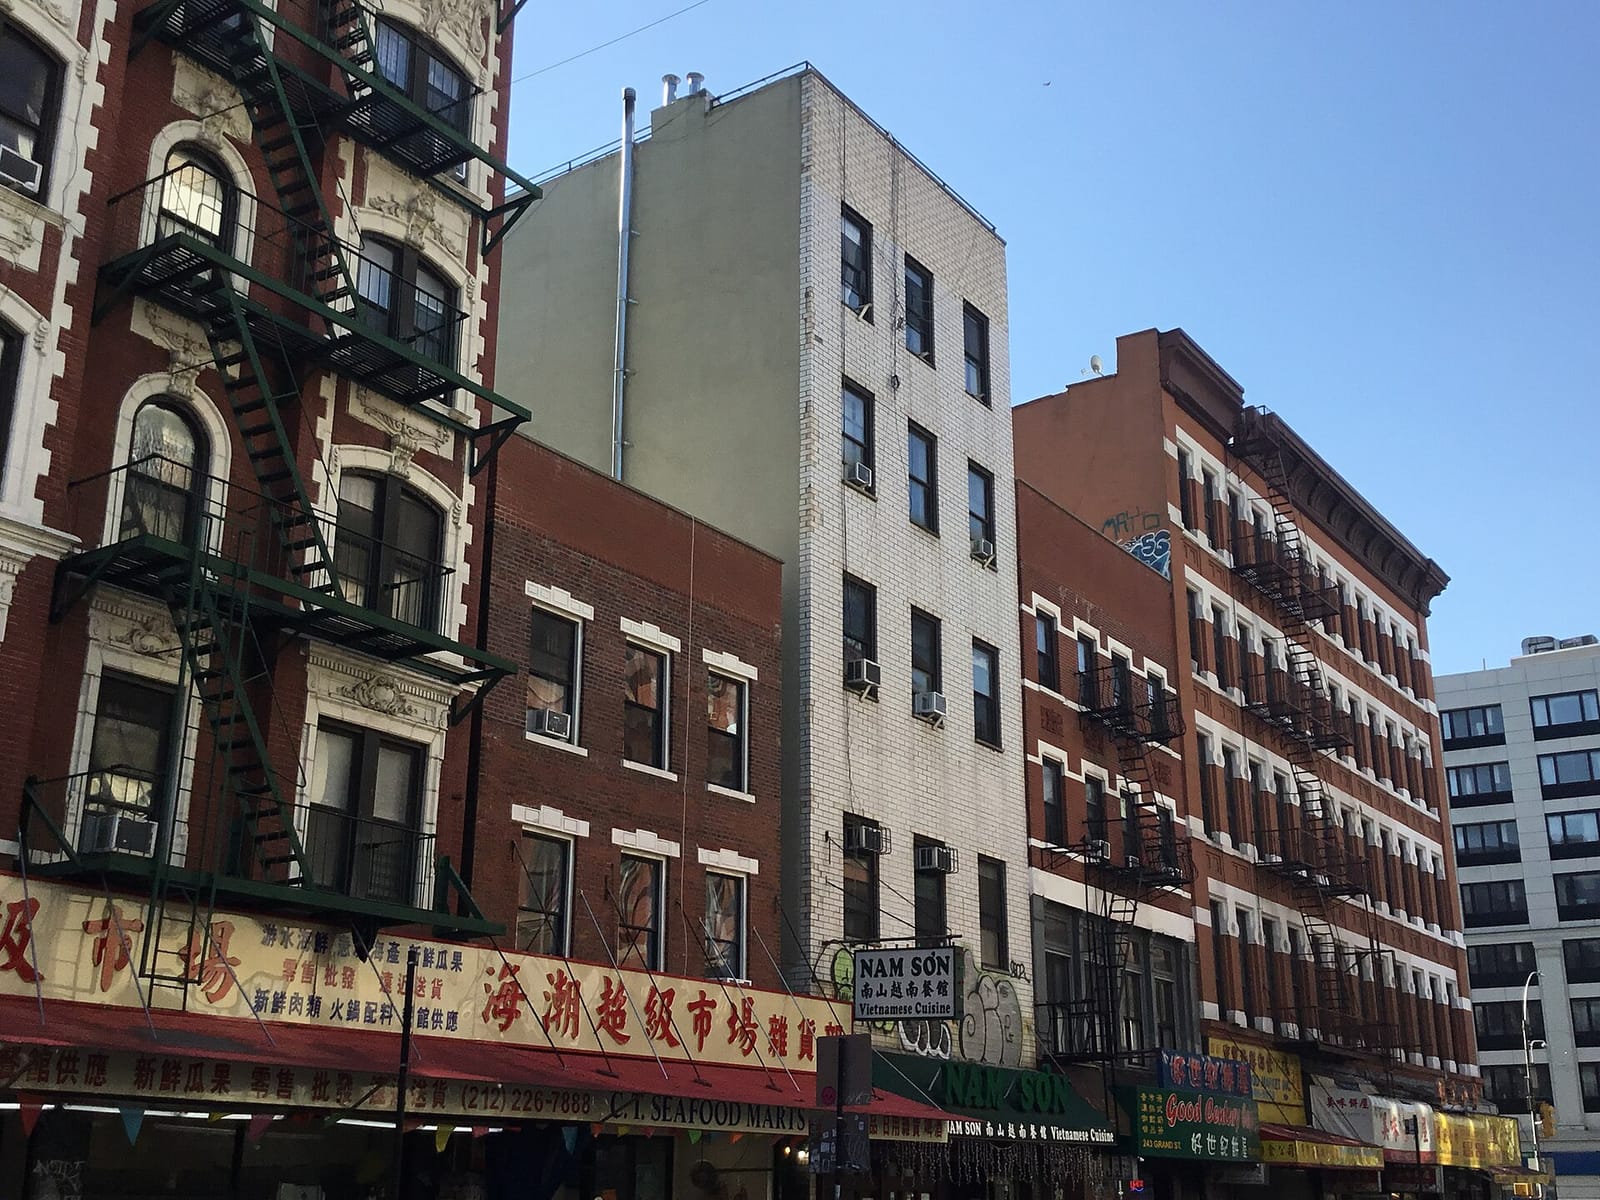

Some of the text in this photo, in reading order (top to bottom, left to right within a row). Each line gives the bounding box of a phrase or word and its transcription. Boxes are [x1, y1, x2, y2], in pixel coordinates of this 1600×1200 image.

[860, 957, 904, 978] NAM
[404, 1006, 459, 1031] 館供應
[860, 1001, 951, 1016] Vietnamese Cuisine
[944, 1062, 1007, 1109] NAM
[460, 1086, 506, 1112] (212)
[511, 1089, 591, 1114] 226-7888
[651, 1094, 741, 1127] SEAFOOD
[747, 1101, 806, 1131] MARTS
[1165, 1092, 1203, 1128] Good
[1050, 1126, 1089, 1142] Vietnamese
[1090, 1128, 1115, 1142] Cuisine
